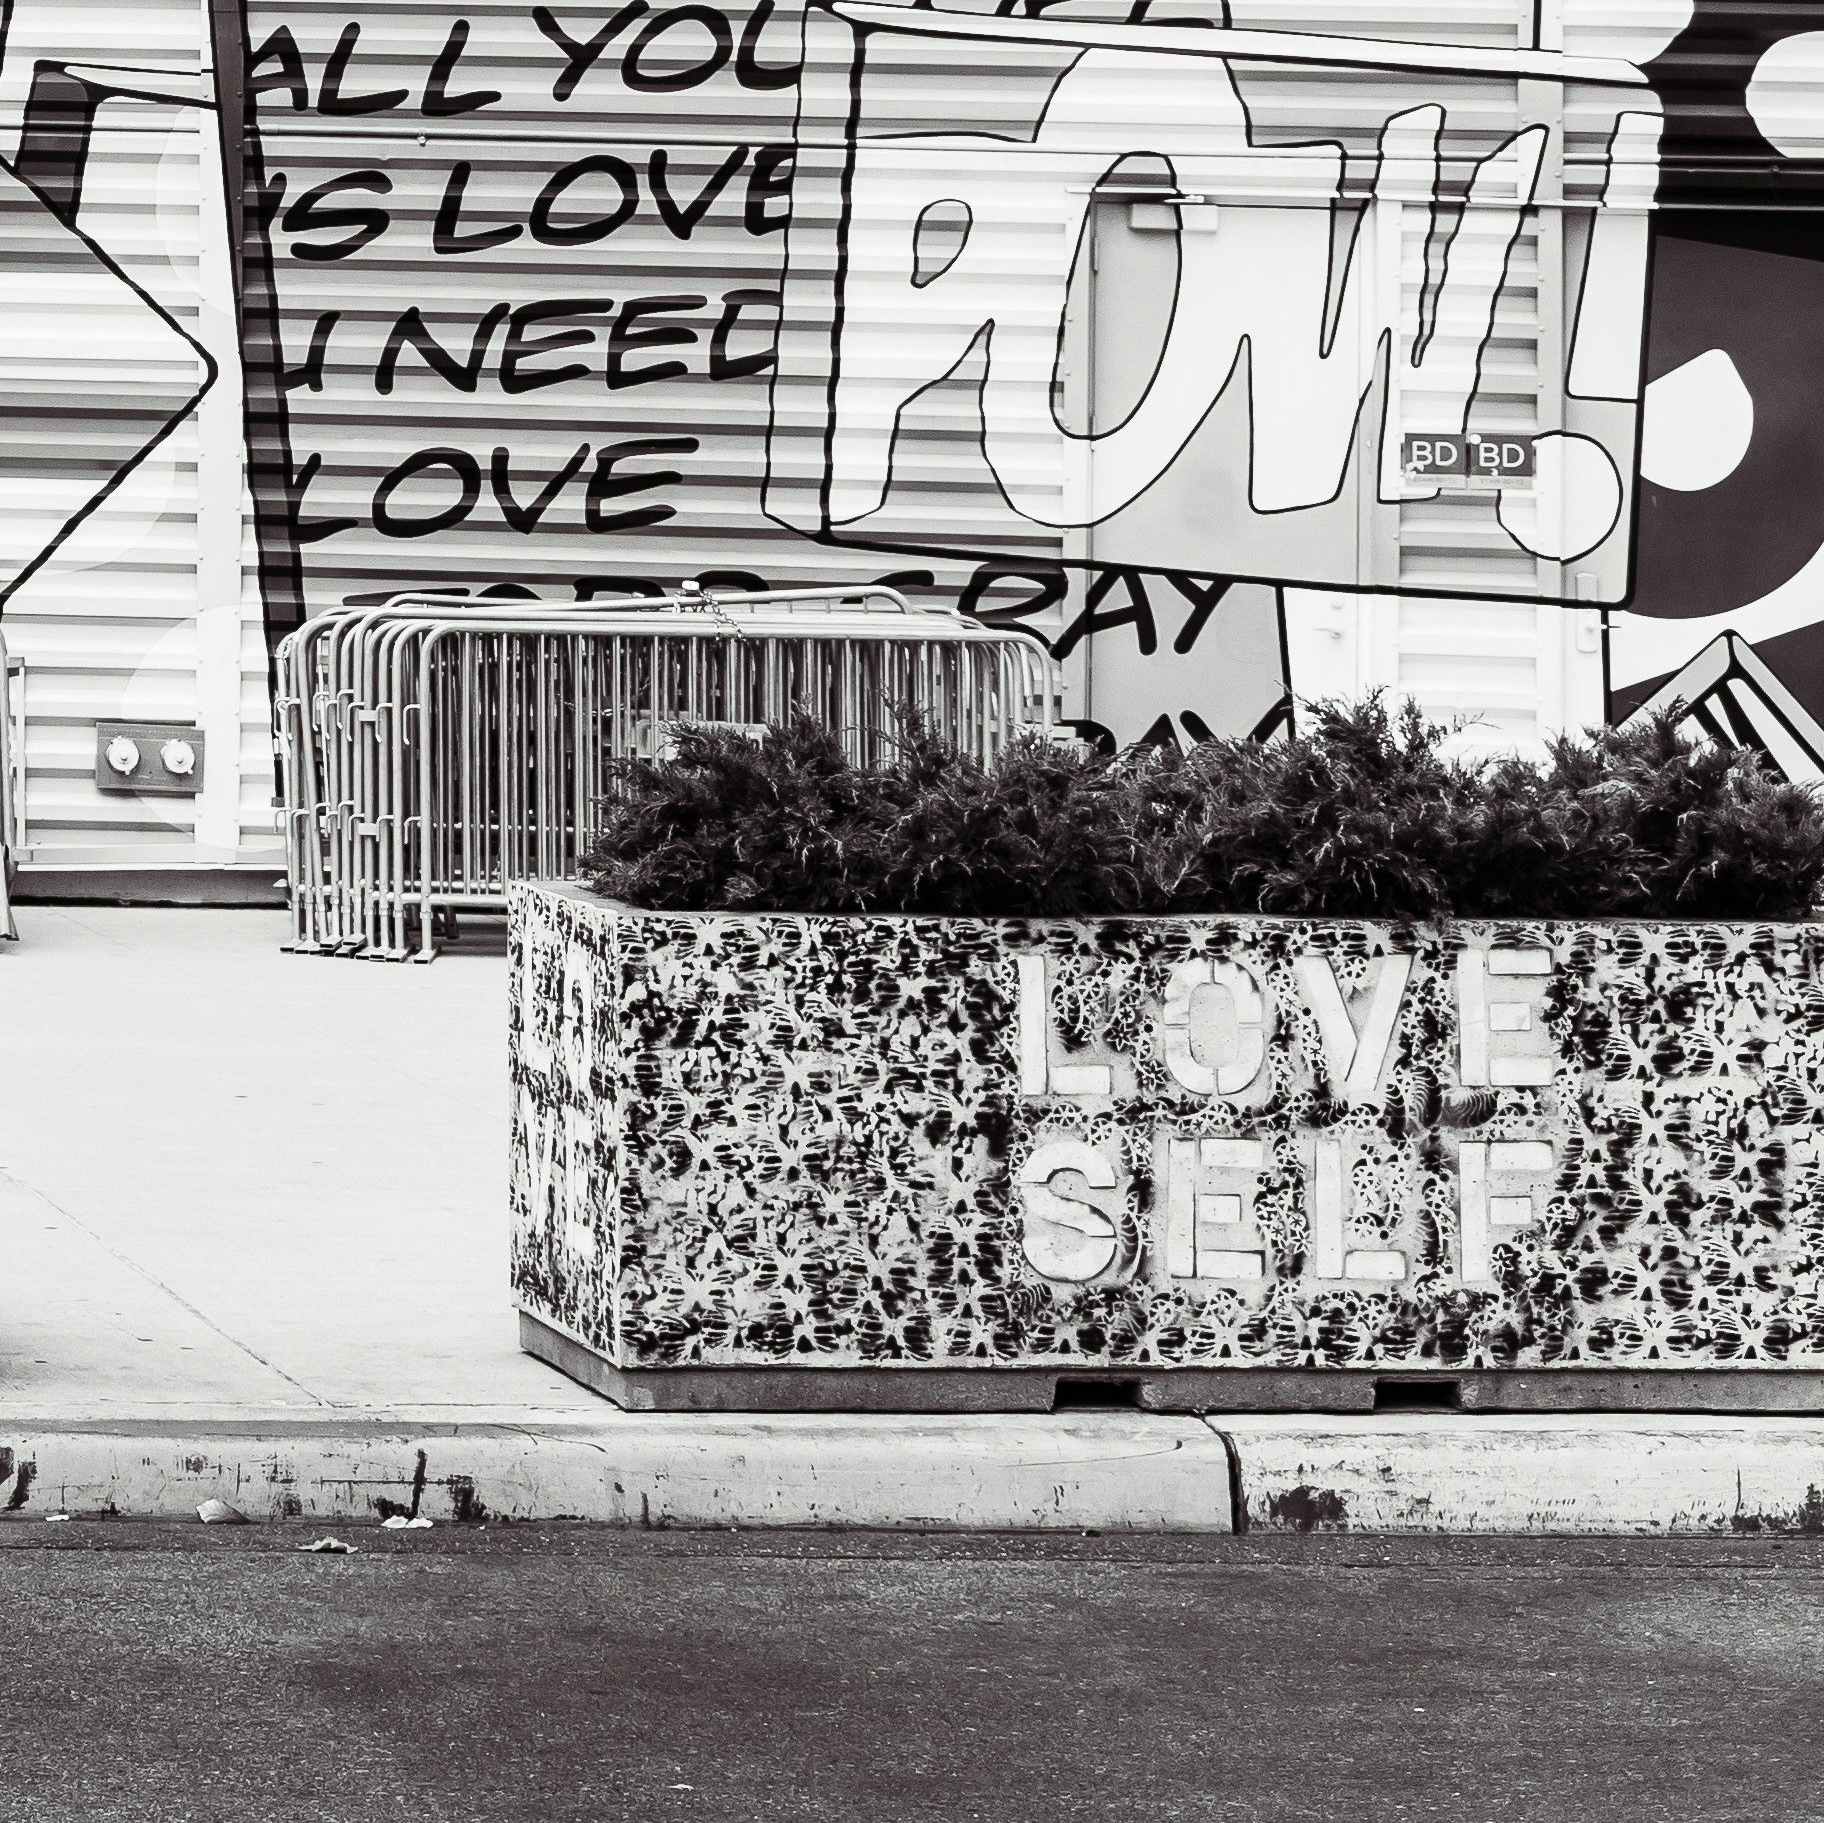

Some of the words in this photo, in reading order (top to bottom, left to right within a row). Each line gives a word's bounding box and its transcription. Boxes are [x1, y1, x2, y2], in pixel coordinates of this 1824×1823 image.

[246, 19, 502, 117] ALL
[432, 143, 798, 256] LOVE
[374, 287, 782, 395] NEED
[290, 436, 699, 544] LOVE
[1411, 440, 1458, 466] BD
[1478, 442, 1525, 468] BD
[1018, 948, 1554, 1097] LOVE
[1019, 1137, 1554, 1283] SELF
